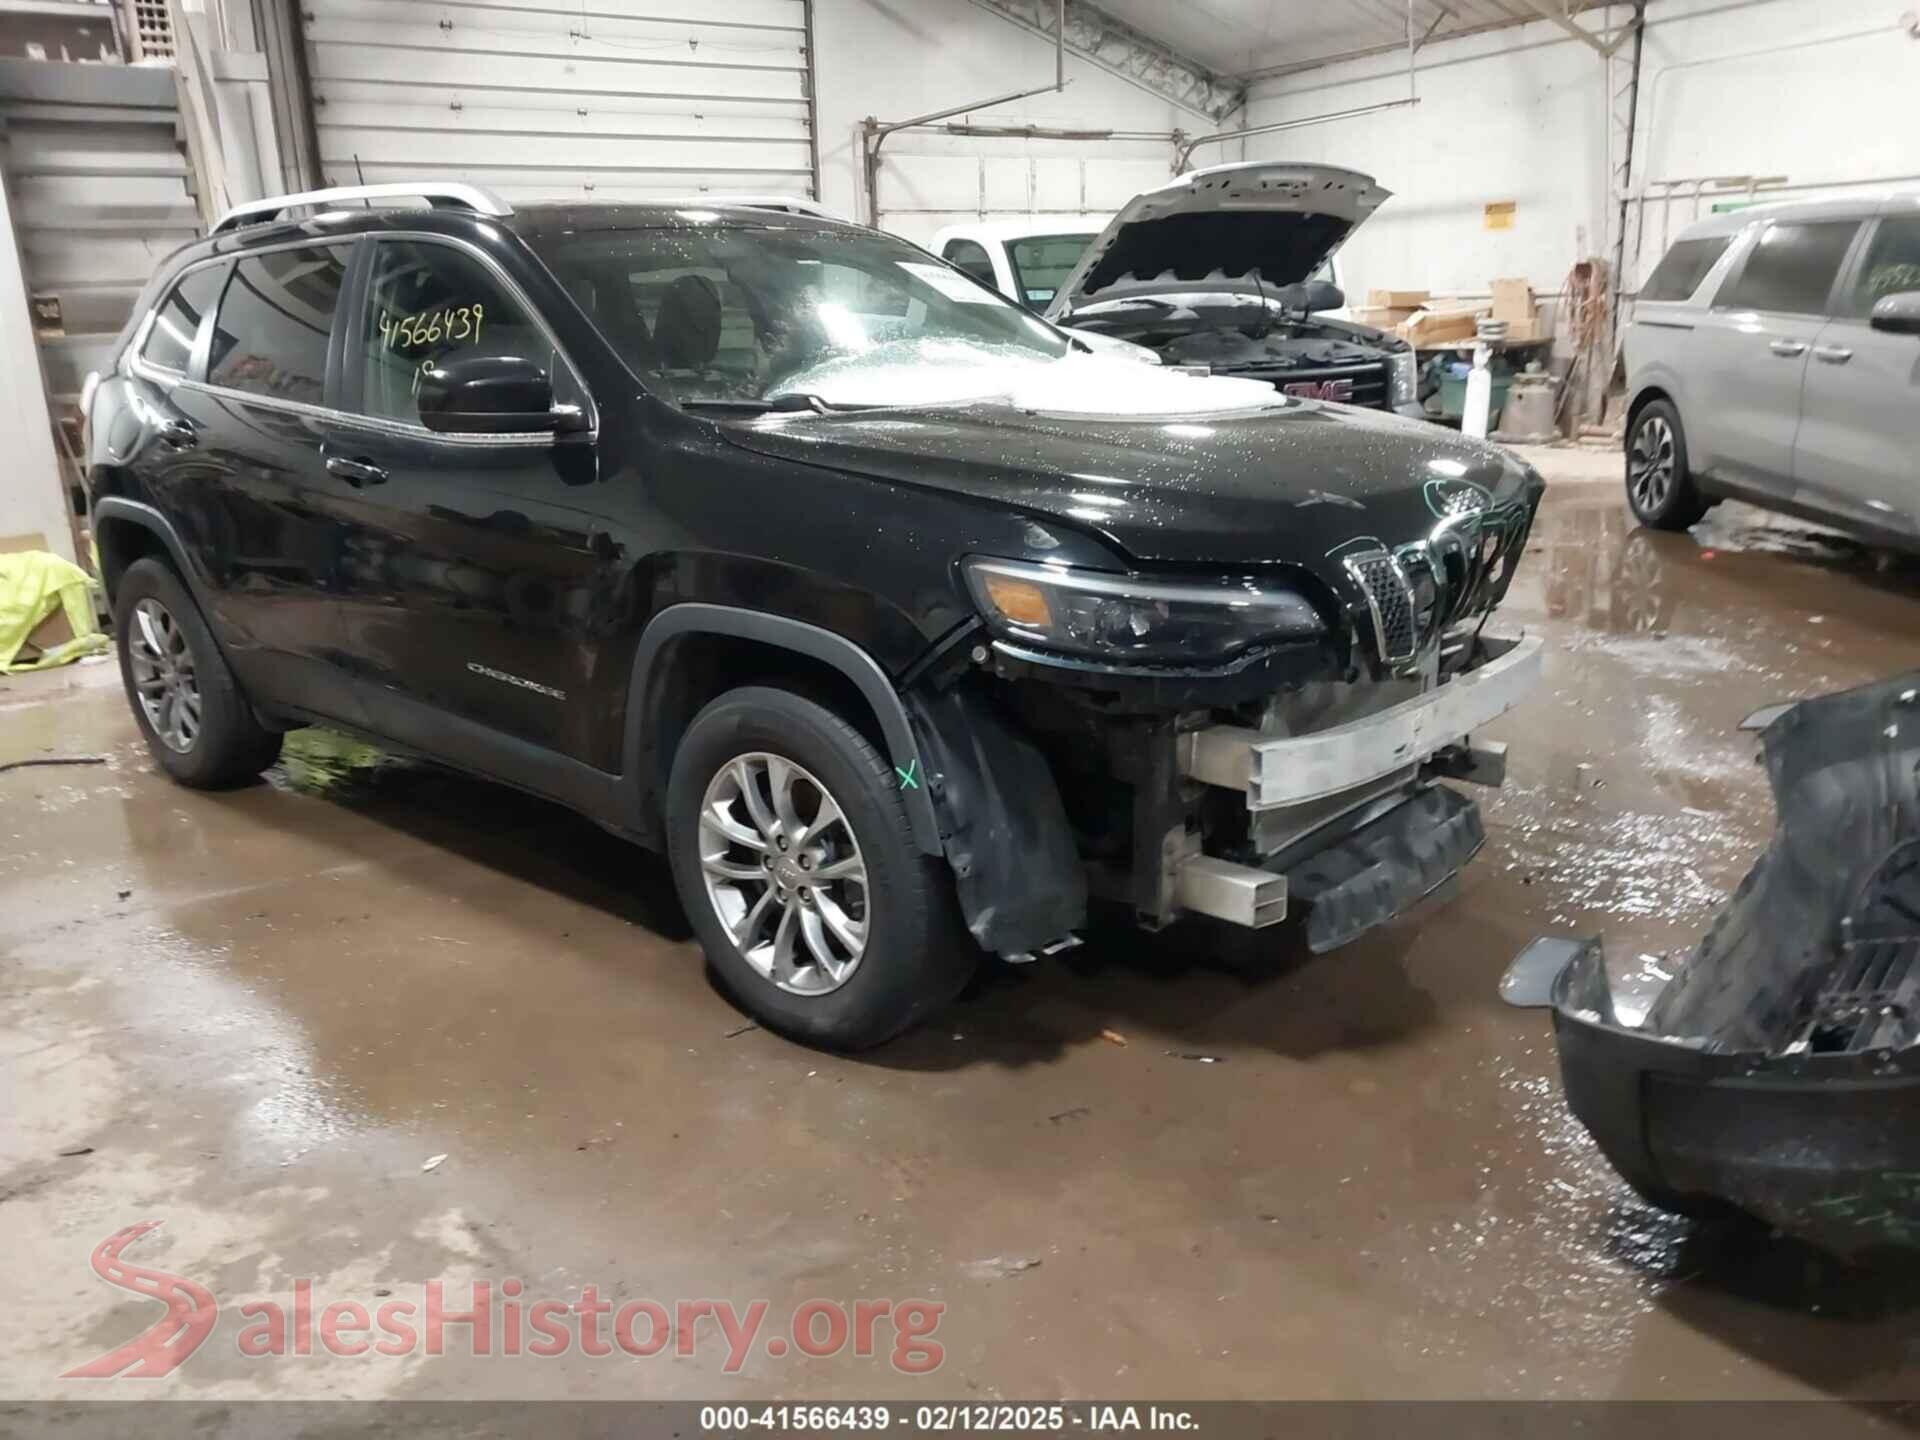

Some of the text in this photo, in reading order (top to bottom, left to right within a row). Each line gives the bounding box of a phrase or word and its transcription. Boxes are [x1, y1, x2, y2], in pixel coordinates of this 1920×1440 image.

[379, 303, 484, 353] 41566439
[1284, 378, 1354, 401] GMC
[466, 661, 567, 701] CHEROKEE
